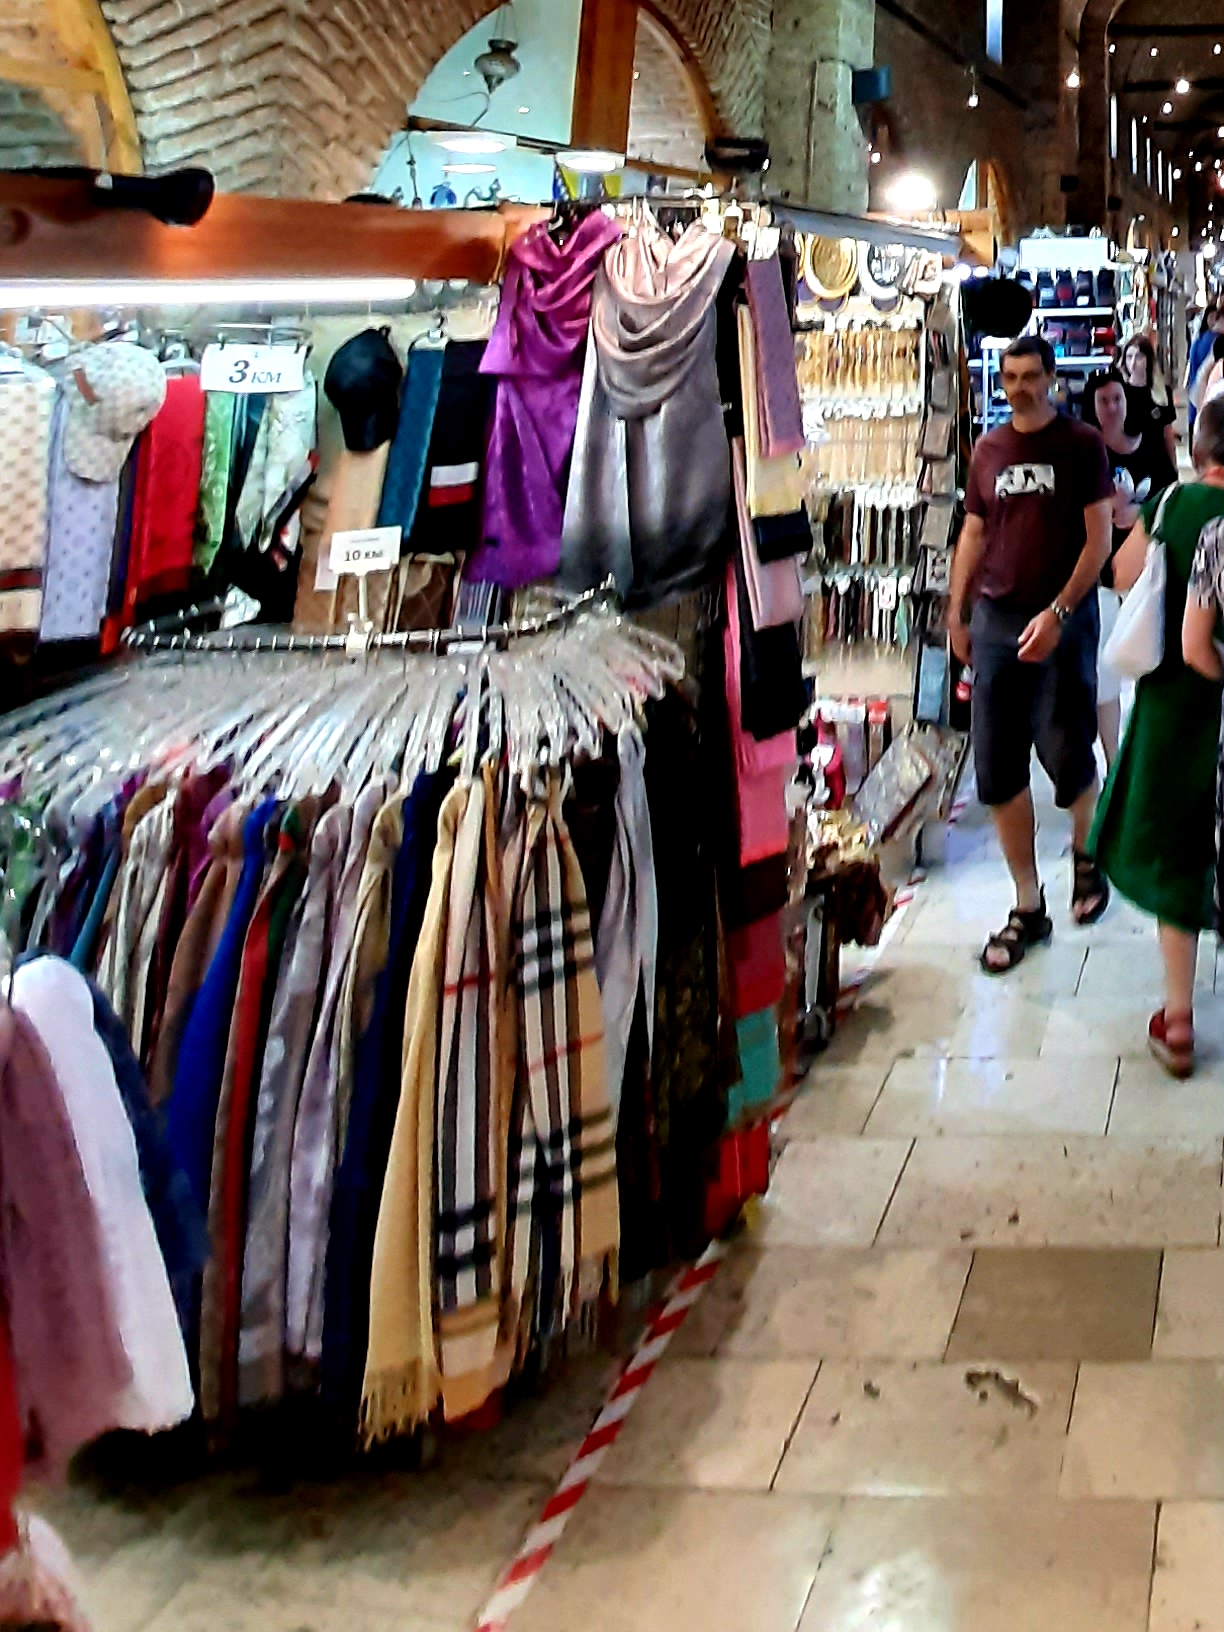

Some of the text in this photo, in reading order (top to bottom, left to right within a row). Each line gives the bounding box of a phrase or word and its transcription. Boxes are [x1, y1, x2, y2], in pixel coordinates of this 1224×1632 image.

[228, 359, 282, 384] 3 KM
[344, 550, 361, 562] 10
